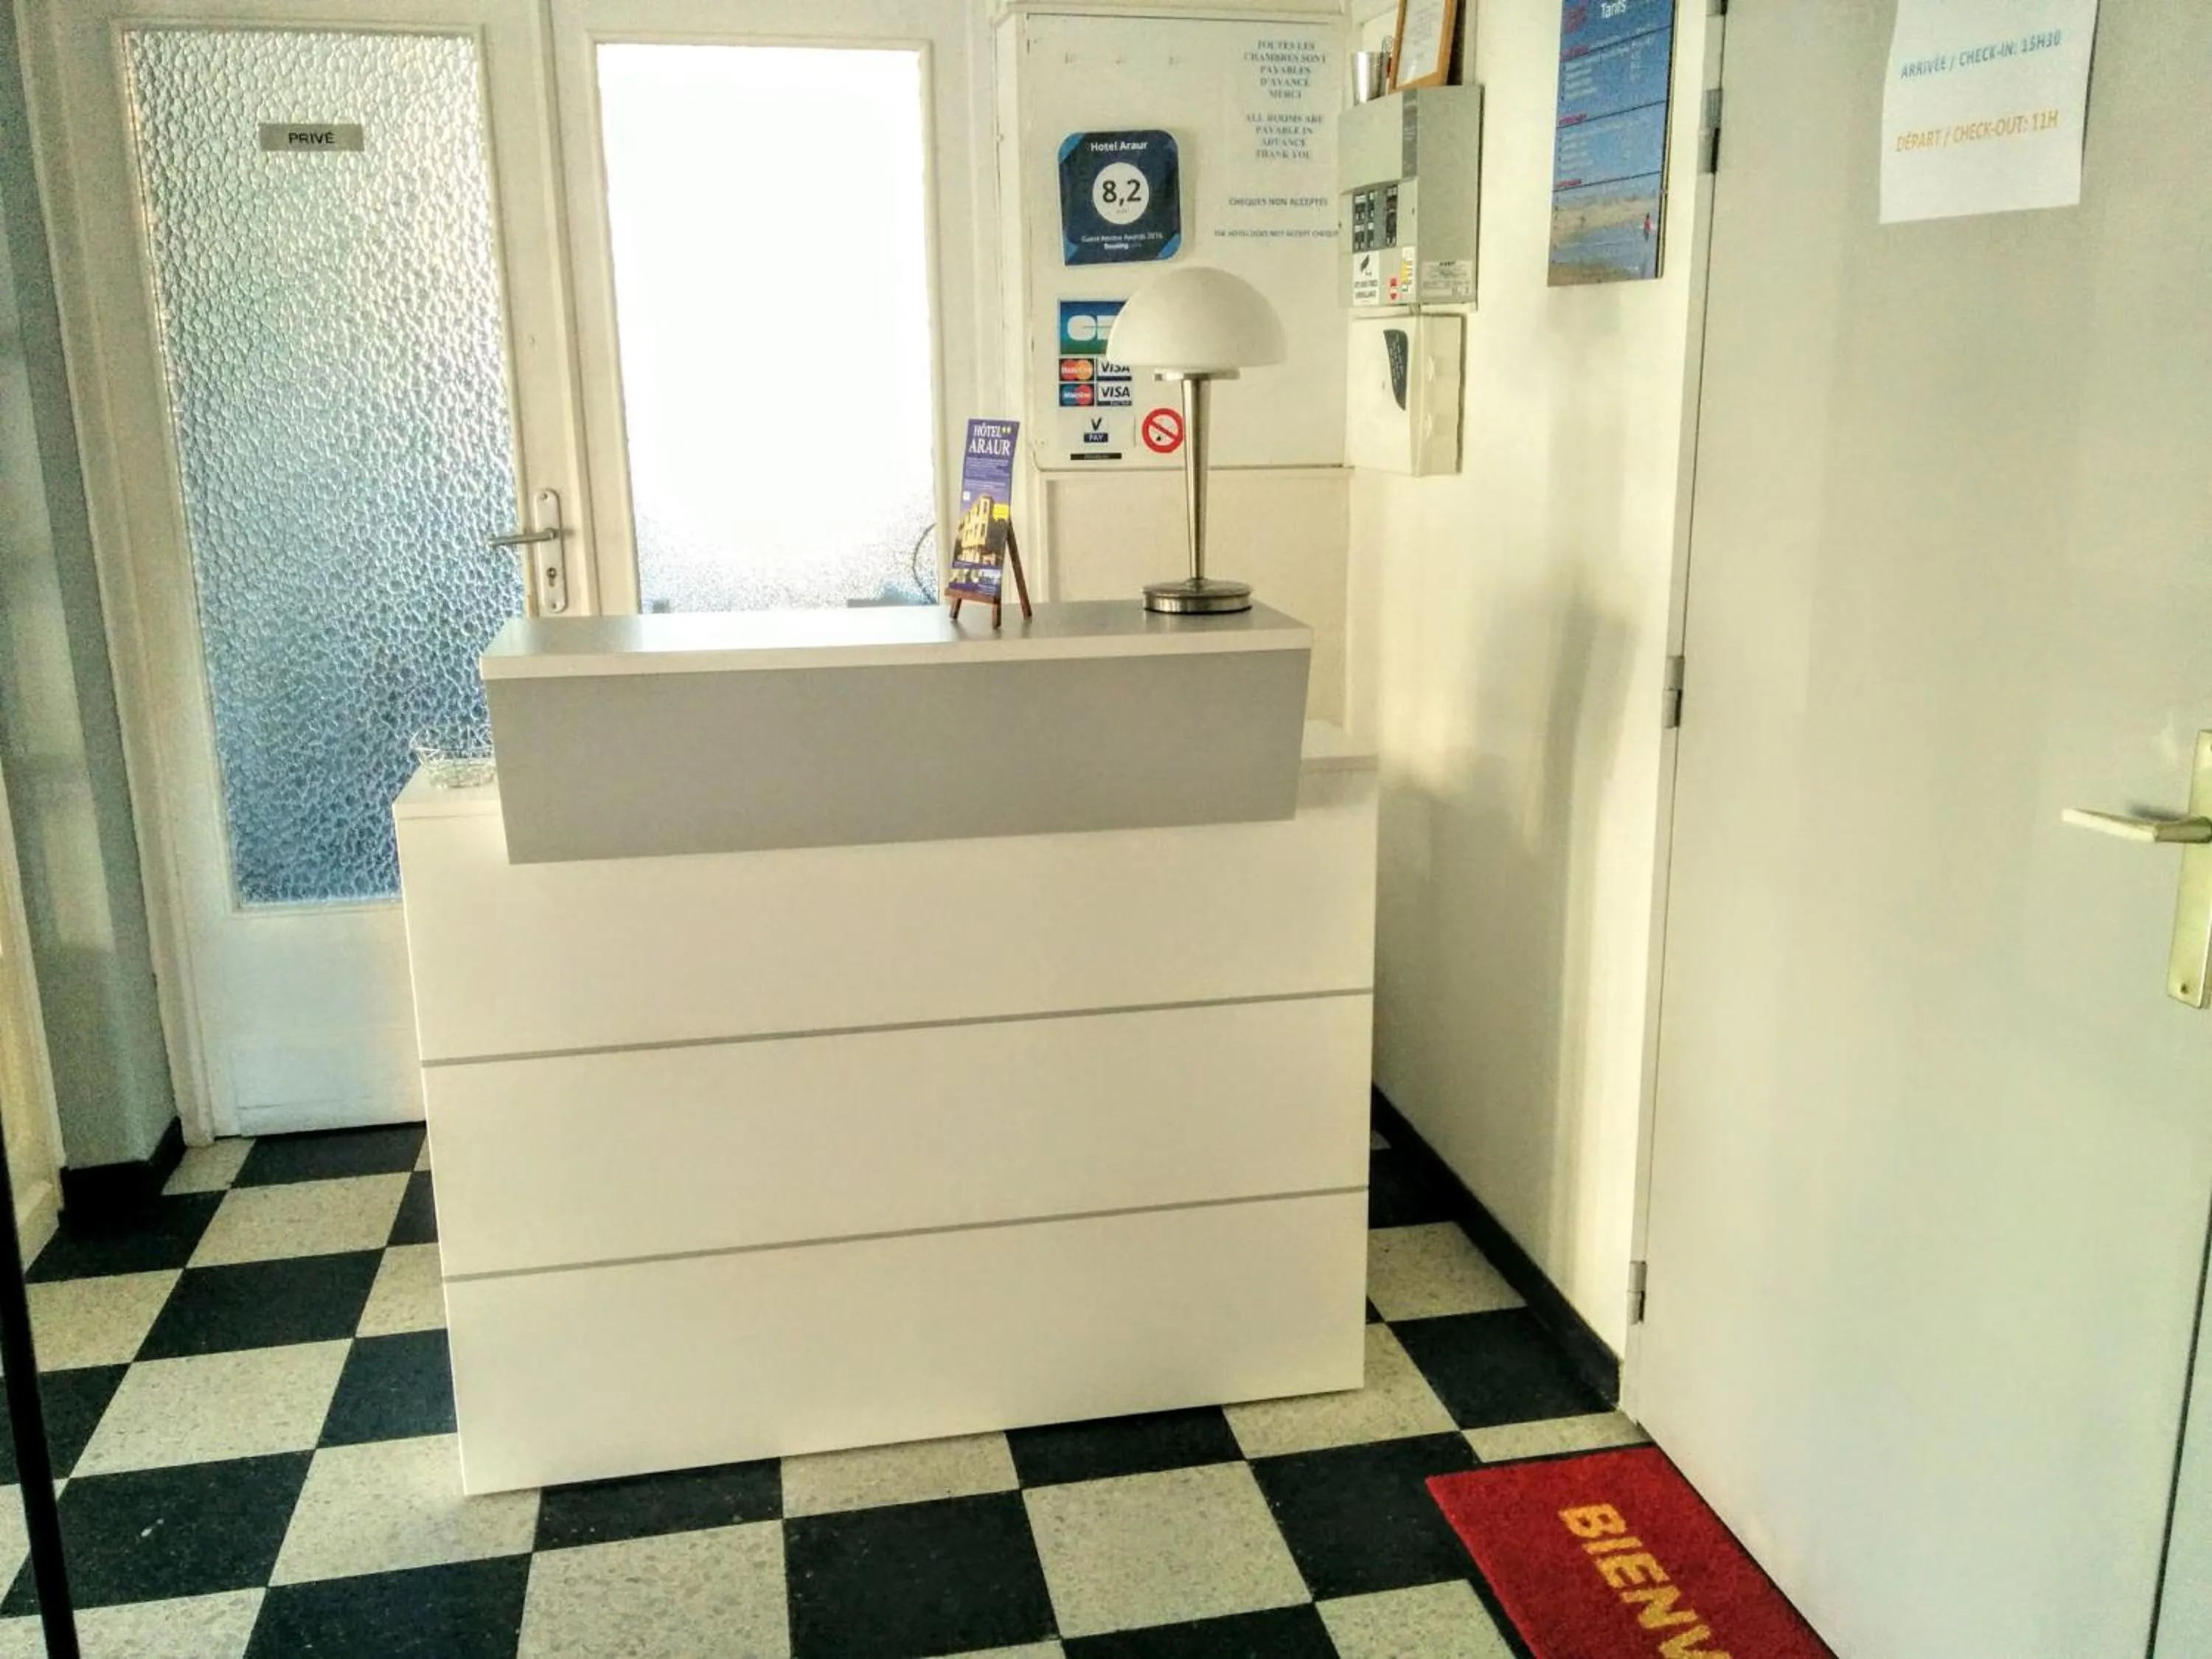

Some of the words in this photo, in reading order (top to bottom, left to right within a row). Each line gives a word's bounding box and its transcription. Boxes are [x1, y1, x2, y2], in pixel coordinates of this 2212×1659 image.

[1900, 55, 1947, 79] ARRIVÉE
[1958, 41, 2017, 67] CHECK-IN:
[288, 131, 335, 145] PRIVÉ
[1895, 129, 1943, 153] DÉPART
[1953, 114, 2028, 143] CHECK-OUT:
[1091, 142, 1118, 151] Hotel
[1120, 141, 1148, 150] Araur
[1102, 178, 1142, 206] 8,2
[1101, 386, 1130, 398] VISA
[973, 422, 1002, 439] HÔTEL
[967, 437, 1011, 456] ARAUR
